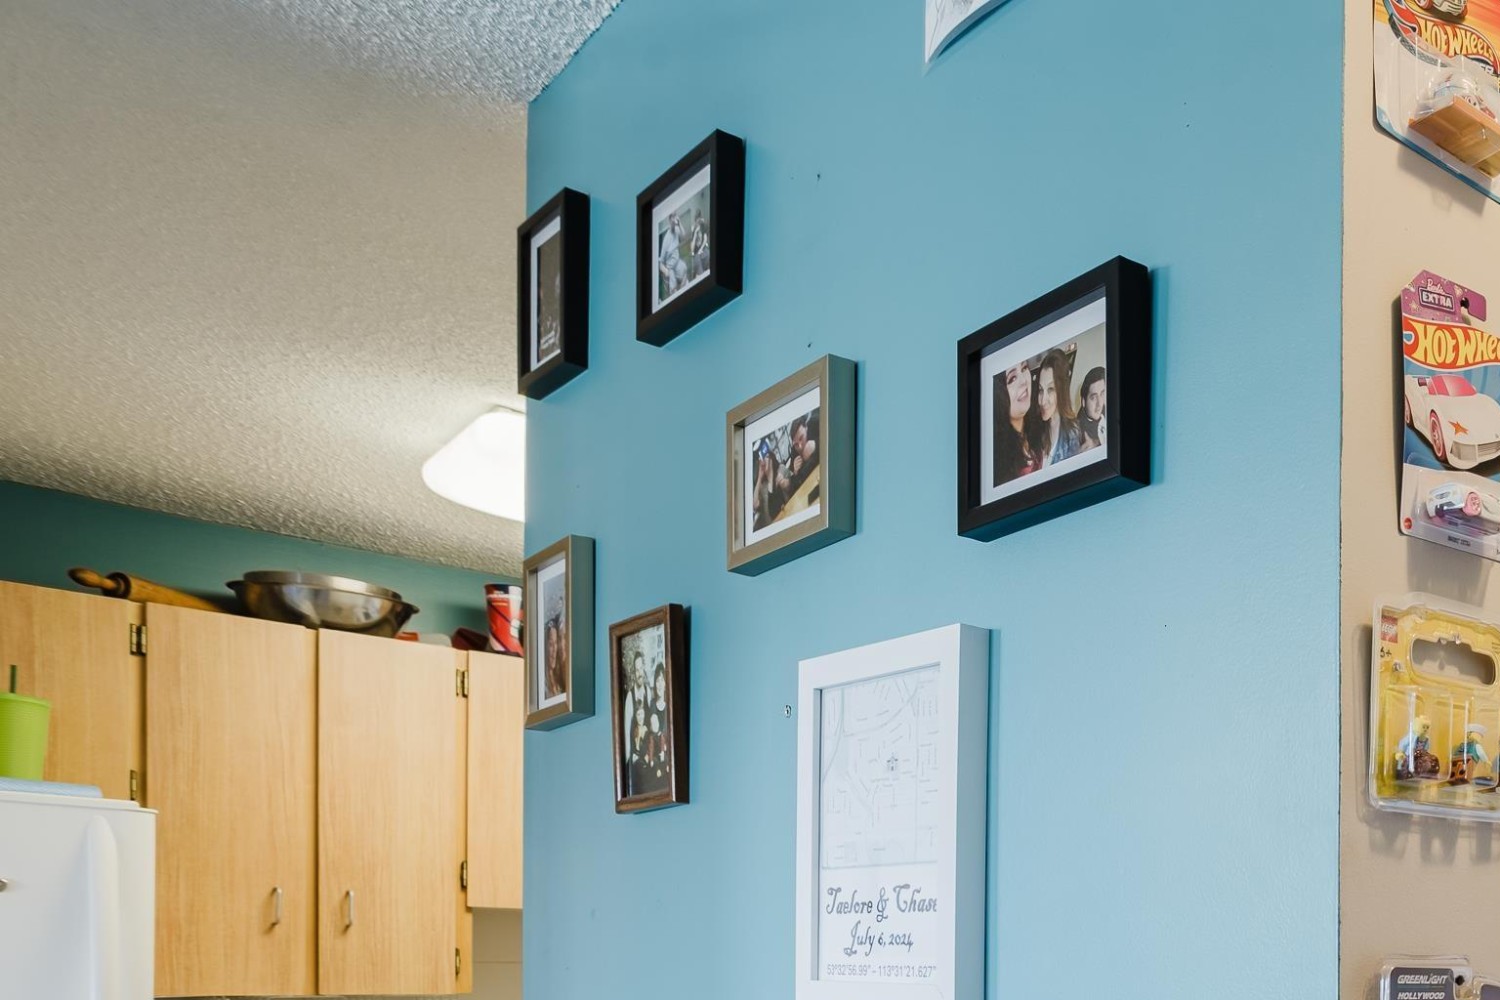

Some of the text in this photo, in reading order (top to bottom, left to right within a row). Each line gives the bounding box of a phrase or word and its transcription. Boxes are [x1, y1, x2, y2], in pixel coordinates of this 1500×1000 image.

[1422, 290, 1453, 308] EXTRA
[876, 887, 889, 923] &
[844, 920, 875, 957] July
[888, 933, 914, 952] 2024
[1397, 991, 1445, 1000] HOLLYWOOD
